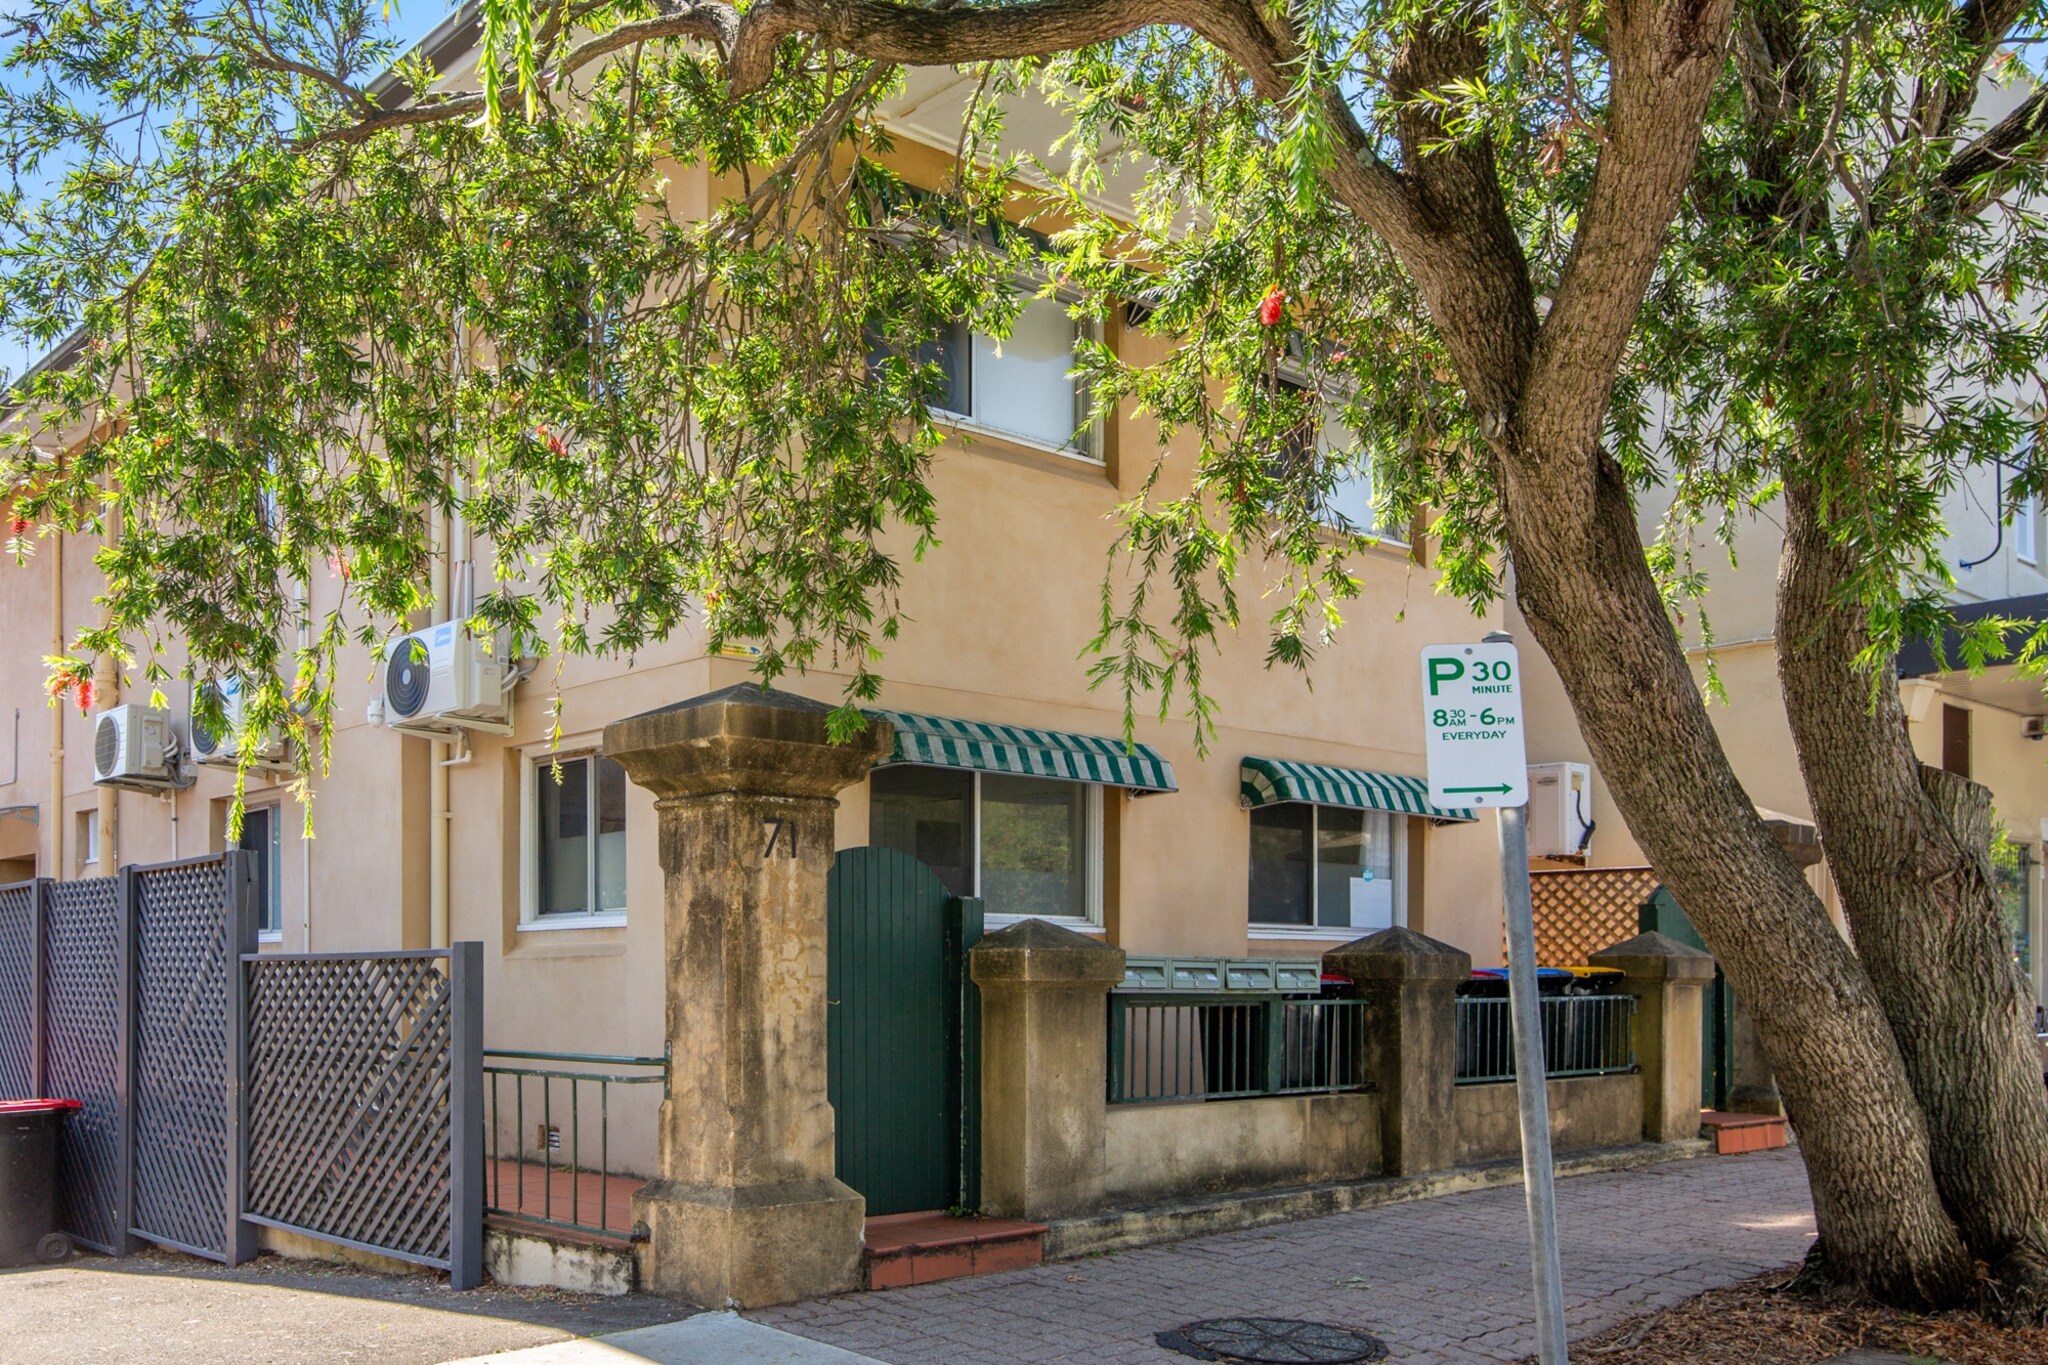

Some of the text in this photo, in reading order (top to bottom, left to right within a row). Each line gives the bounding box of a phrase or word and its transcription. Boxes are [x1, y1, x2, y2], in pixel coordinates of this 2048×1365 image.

[1428, 658, 1511, 695] P 30
[1472, 685, 1513, 694] MINUTE
[1442, 730, 1507, 741] EVERYDAY
[763, 817, 797, 858] 71
